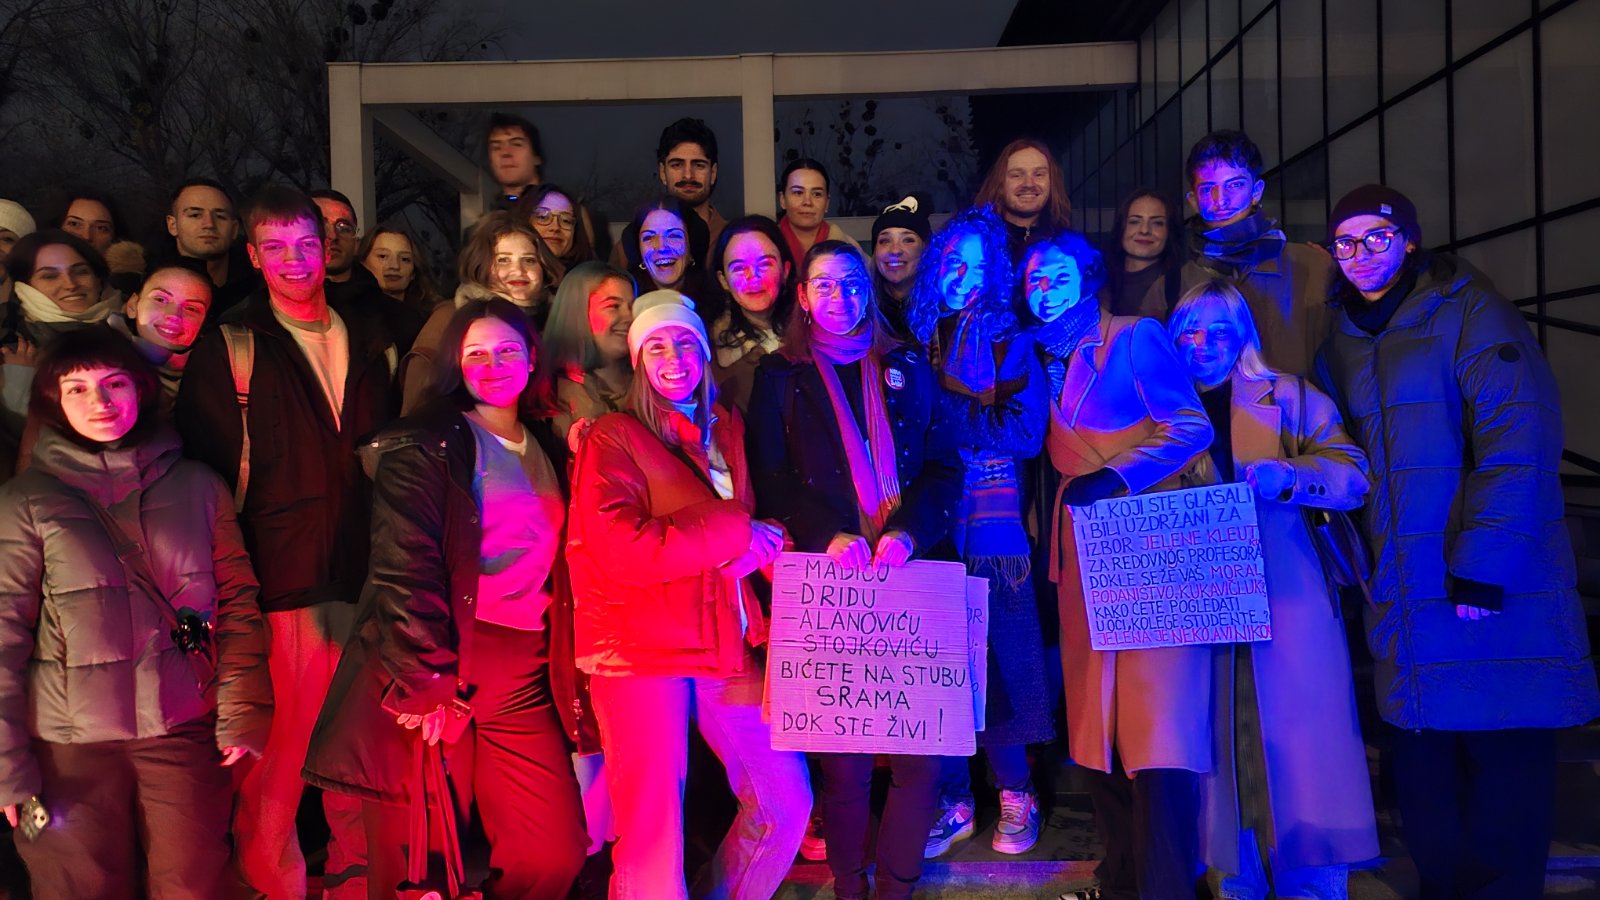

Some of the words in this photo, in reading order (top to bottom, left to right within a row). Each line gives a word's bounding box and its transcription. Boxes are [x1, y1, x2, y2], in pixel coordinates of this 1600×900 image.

[1108, 500, 1143, 518] KOJI
[1148, 495, 1178, 513] STE
[1184, 487, 1252, 510] GLASALI
[1081, 524, 1086, 539] I
[1090, 520, 1120, 539] BILI
[1124, 509, 1209, 533] UZDRŽANI
[1216, 506, 1241, 523] ZA
[1085, 537, 1134, 557] IZBOR
[1138, 530, 1203, 551] JELENE
[1207, 526, 1258, 545] KLEUT
[1087, 559, 1109, 573] ZA
[1112, 548, 1185, 571] REDOVNOG
[1188, 546, 1263, 563] PROFESORA
[1089, 573, 1136, 590] DOKLE
[1141, 567, 1177, 586] SEŽE
[1178, 563, 1205, 582] VAŠ
[801, 582, 876, 609] DRIDU
[1093, 603, 1129, 619] KAKO
[1170, 597, 1240, 614] POGLEDATI
[800, 609, 920, 635] ALANOVIĆU
[803, 634, 938, 659] STOJKOVIĆU
[1097, 631, 1152, 646] JELENA
[1154, 629, 1170, 642] JE
[781, 658, 854, 683] BIĆETE
[864, 664, 895, 684] NA
[904, 665, 966, 687] STUBU
[816, 686, 911, 710] SRAMA
[782, 711, 823, 732] DOK
[834, 716, 874, 737] STE
[887, 715, 926, 740] ŽIVI
